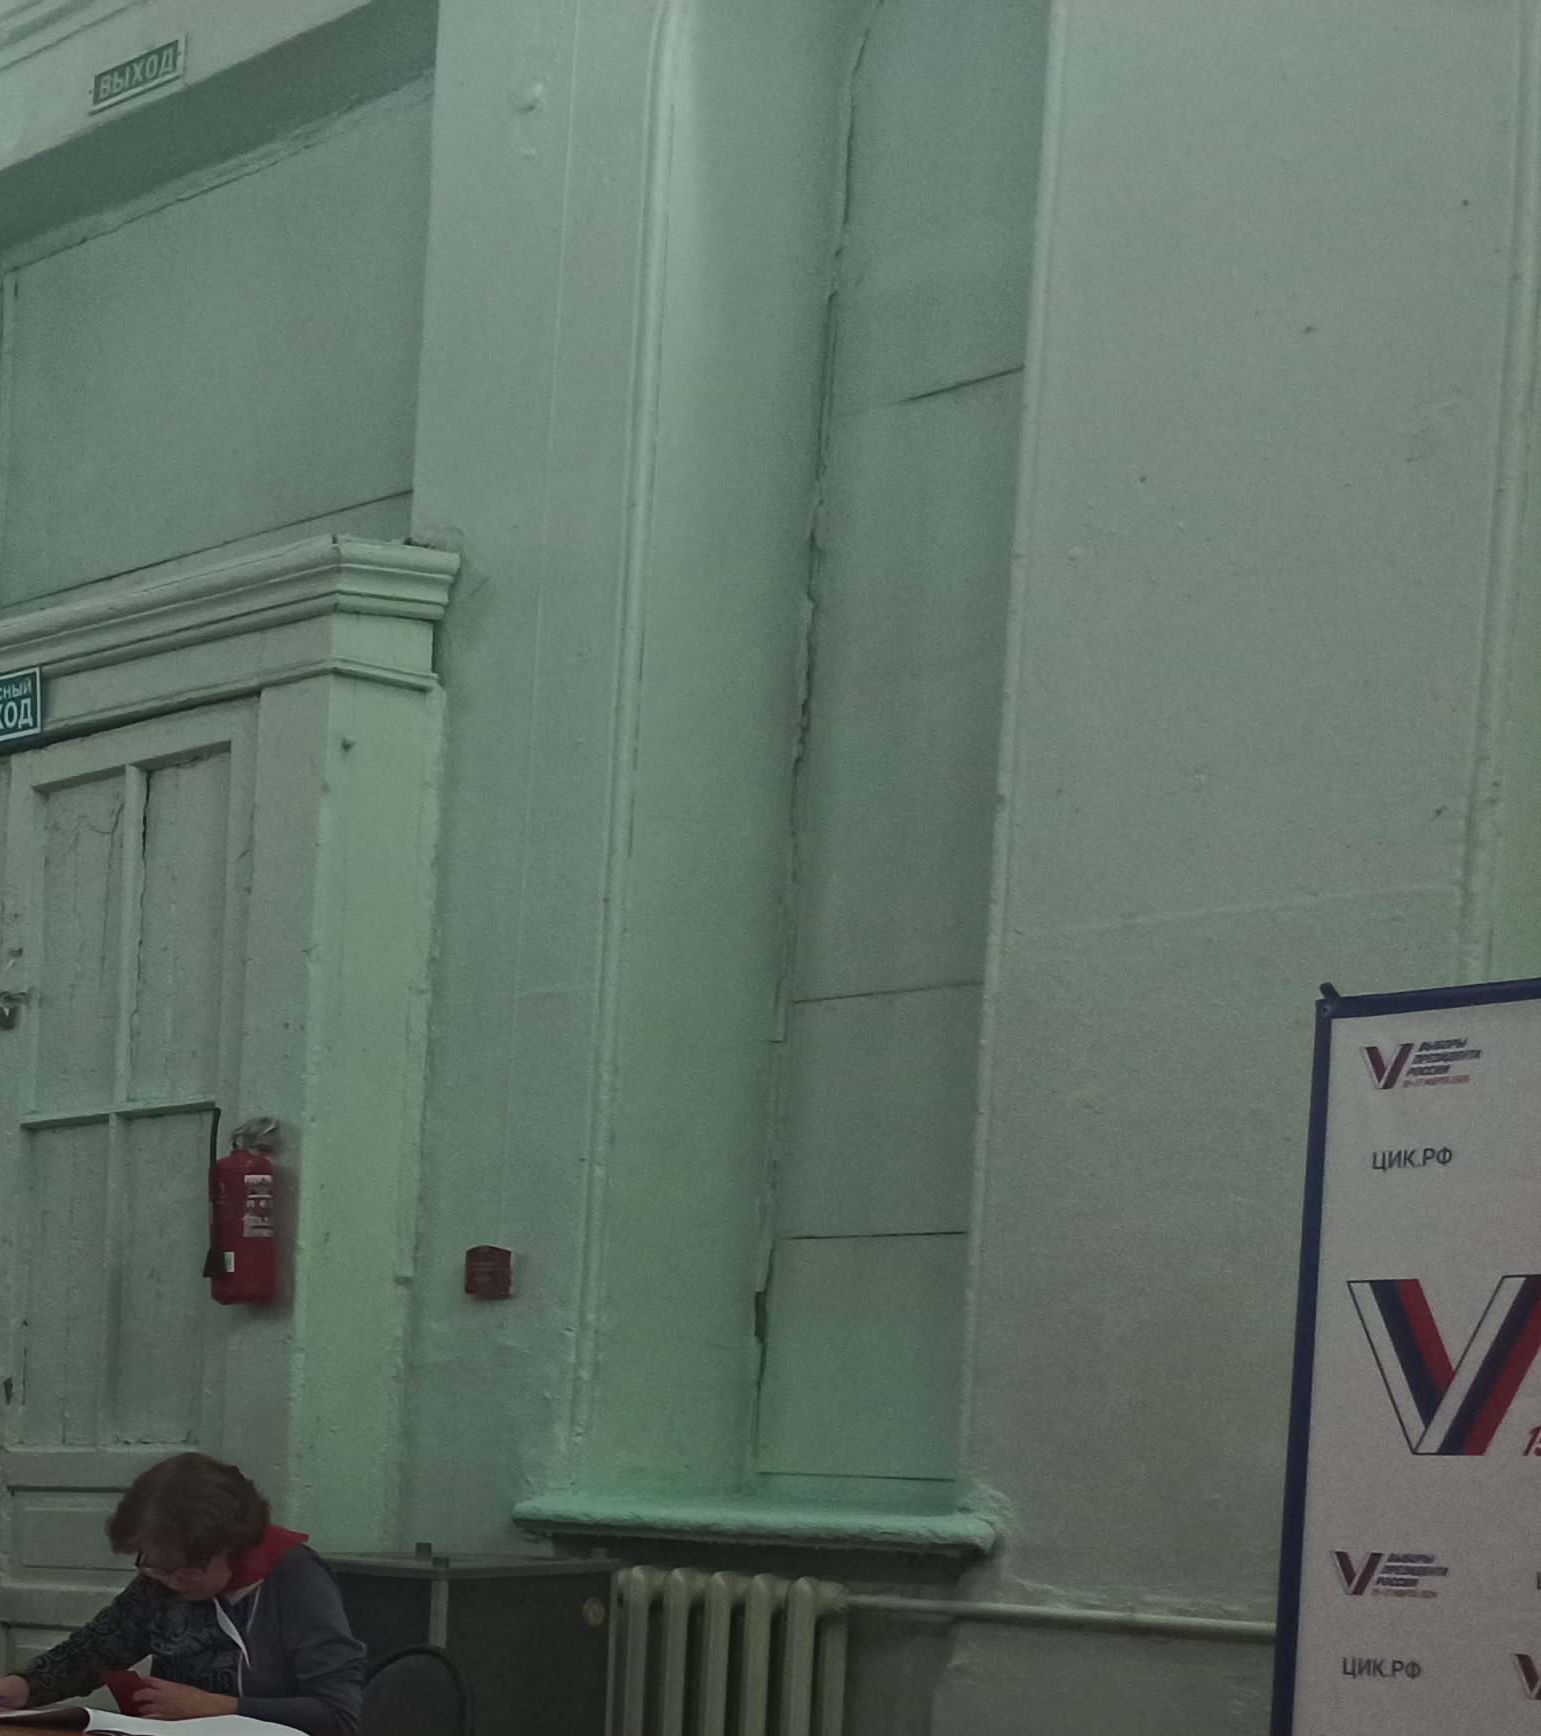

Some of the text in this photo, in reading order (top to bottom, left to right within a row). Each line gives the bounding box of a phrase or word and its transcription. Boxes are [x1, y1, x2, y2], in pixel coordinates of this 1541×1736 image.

[99, 45, 175, 100] ВЫХОД
[1372, 1146, 1453, 1172] ЦИК.РФ
[1342, 1656, 1422, 1680] ЦИК.РФ
